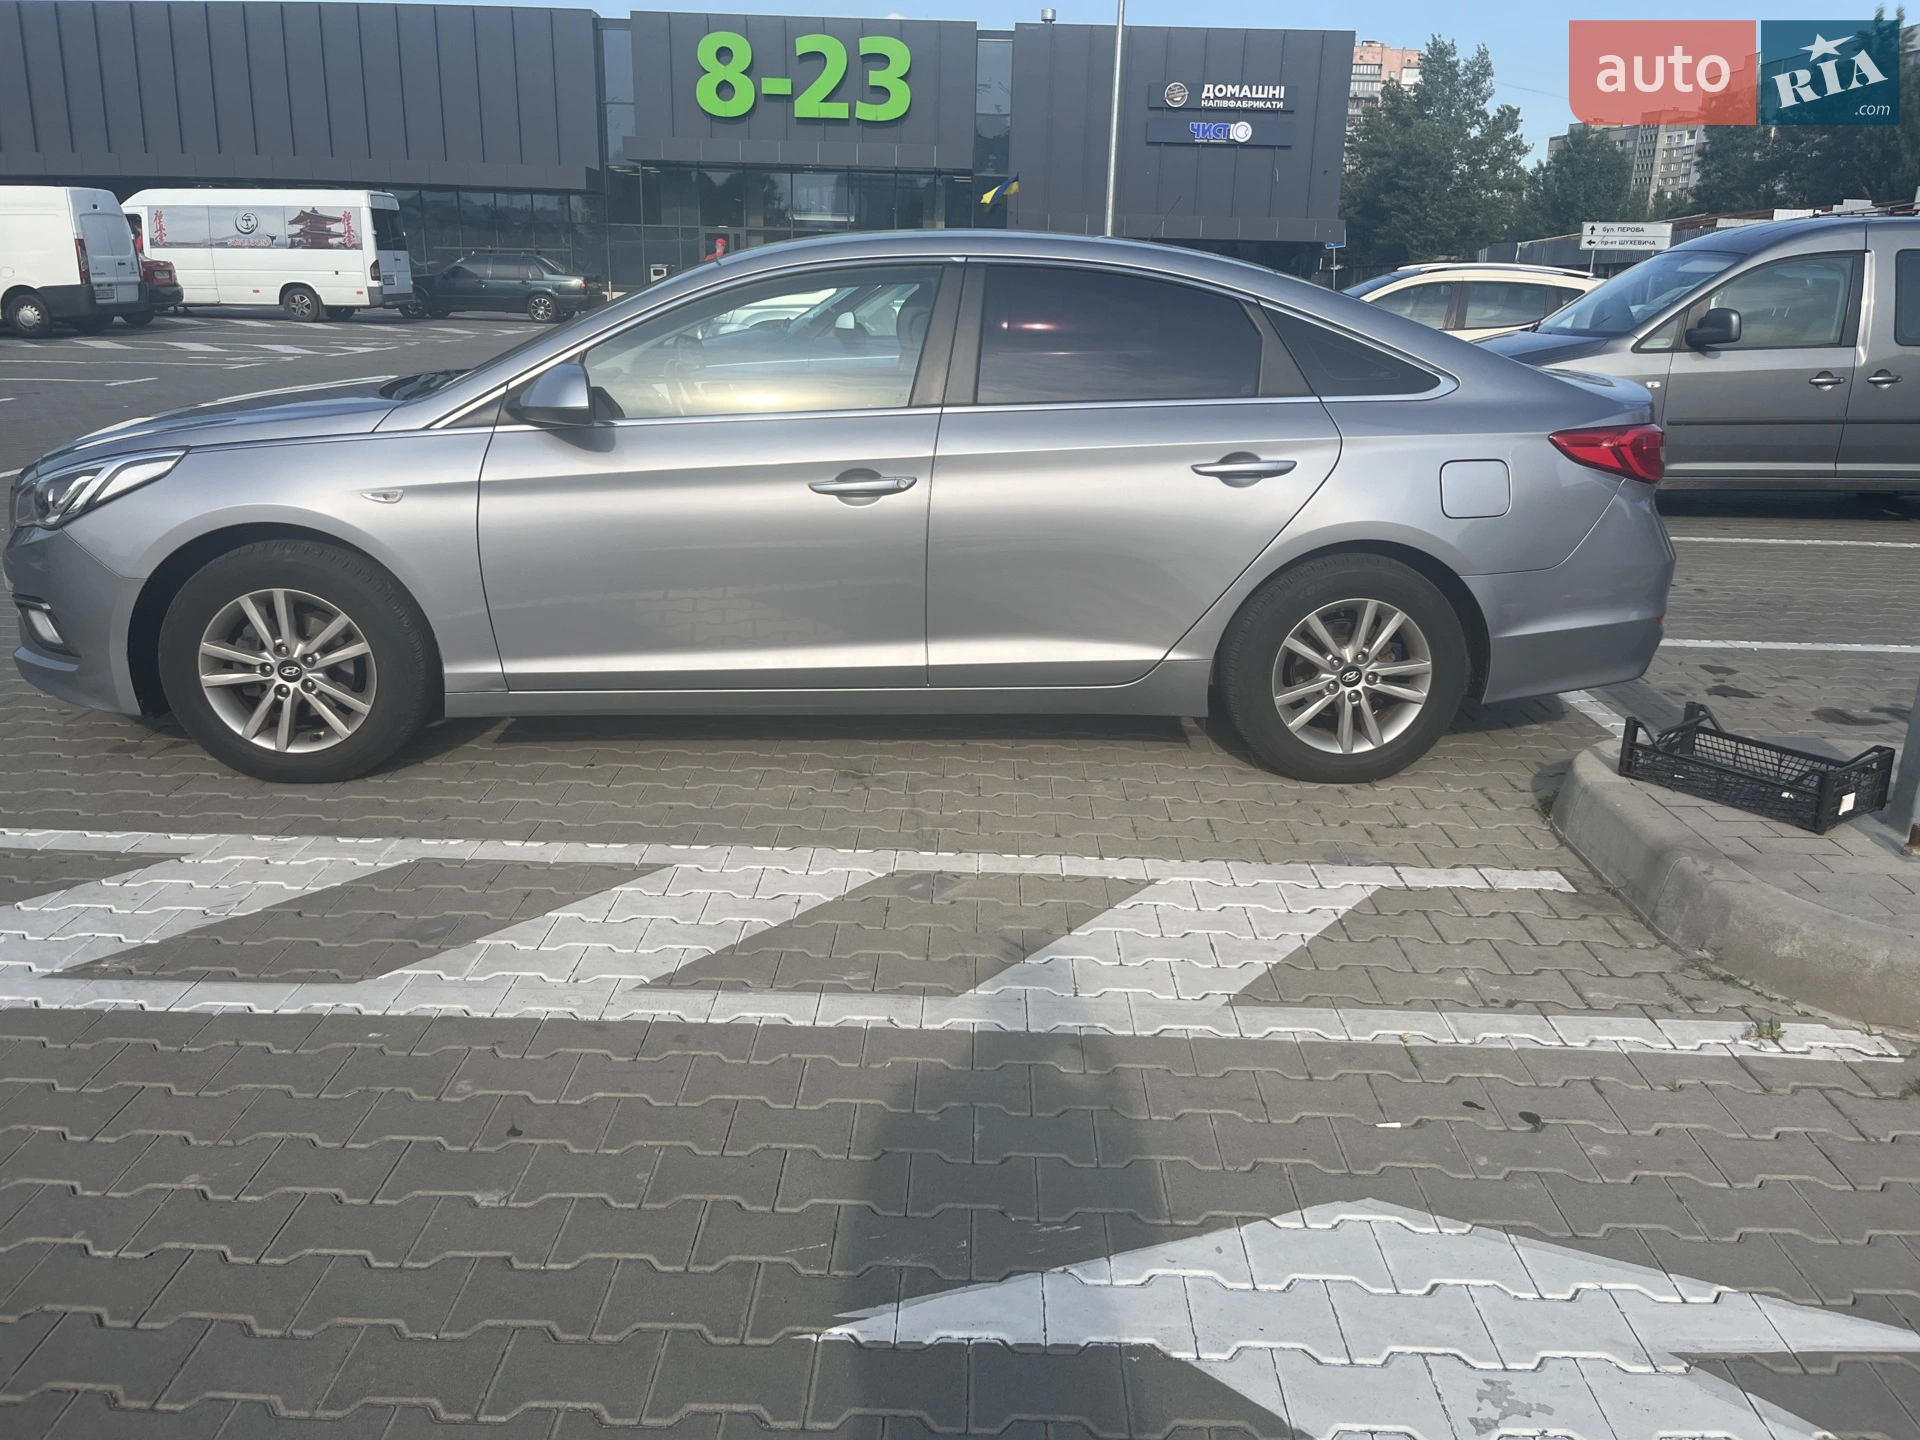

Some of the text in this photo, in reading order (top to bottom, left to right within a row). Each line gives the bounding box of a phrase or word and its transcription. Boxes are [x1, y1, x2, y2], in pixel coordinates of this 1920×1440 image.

[696, 31, 911, 121] 8-23
[1202, 84, 1285, 99] ДОМАШНІ
[1201, 99, 1284, 109] НАПІВФАБРИКАТИ
